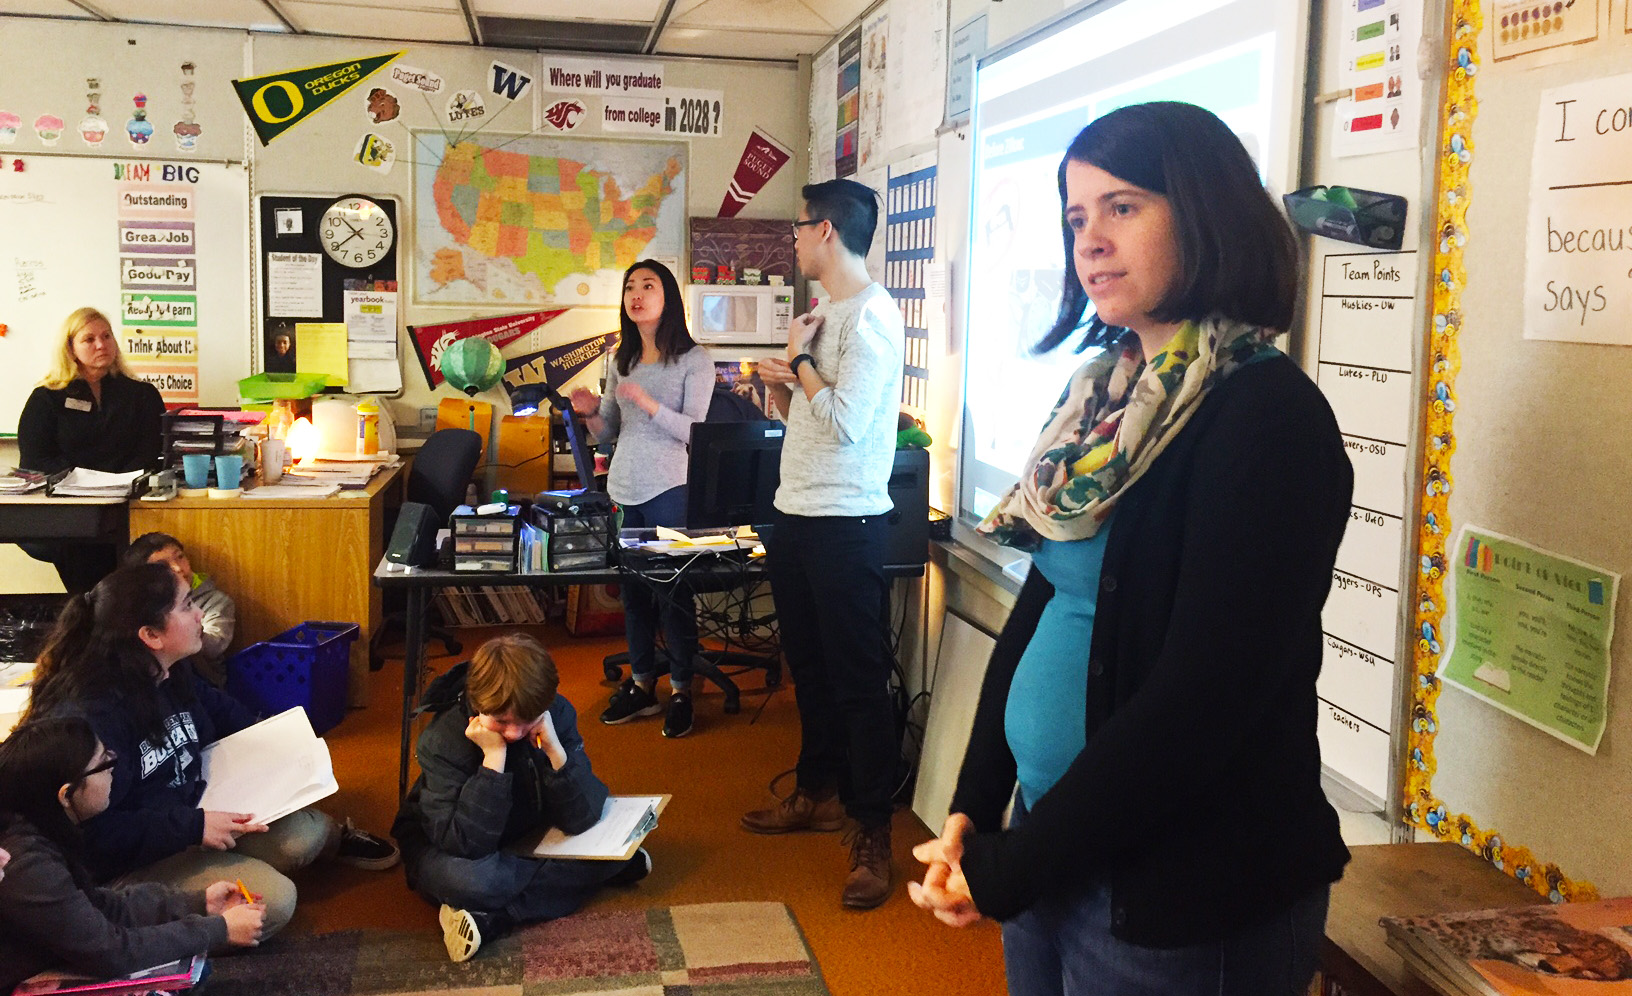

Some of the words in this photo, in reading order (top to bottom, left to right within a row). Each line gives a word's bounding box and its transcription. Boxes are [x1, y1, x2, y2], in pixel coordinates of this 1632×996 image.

[304, 62, 362, 90] OREGON
[312, 72, 361, 96] DUCKS
[493, 64, 531, 100] W
[550, 68, 581, 88] Where
[584, 70, 601, 88] will
[605, 73, 621, 89] you
[623, 72, 662, 91] graduate
[252, 80, 304, 124] O
[449, 105, 485, 121] LUTES
[605, 105, 625, 122] from
[628, 108, 661, 127] college
[665, 97, 676, 131] in
[1555, 99, 1577, 142] I
[162, 164, 200, 183] BIG
[744, 158, 770, 179] SOUND
[125, 193, 188, 209] Outstanding
[328, 217, 341, 227] 10
[376, 217, 384, 226] 2
[125, 231, 160, 243] Grea
[166, 232, 189, 243] Job
[325, 230, 334, 239] 9
[380, 229, 388, 238] 3
[375, 241, 384, 250] 4
[341, 250, 348, 259] 7
[354, 253, 363, 263] 6
[367, 250, 376, 259] 5
[1342, 262, 1370, 281] Team
[1373, 260, 1401, 283] Points
[351, 296, 384, 304] yearbook
[508, 316, 536, 327] University
[485, 327, 520, 342] OUGARS
[156, 340, 182, 354] About
[550, 336, 606, 368] WASHINGTON
[562, 348, 600, 371] HUSKIES
[167, 374, 193, 389] Choice
[1328, 706, 1360, 733] Teachers
